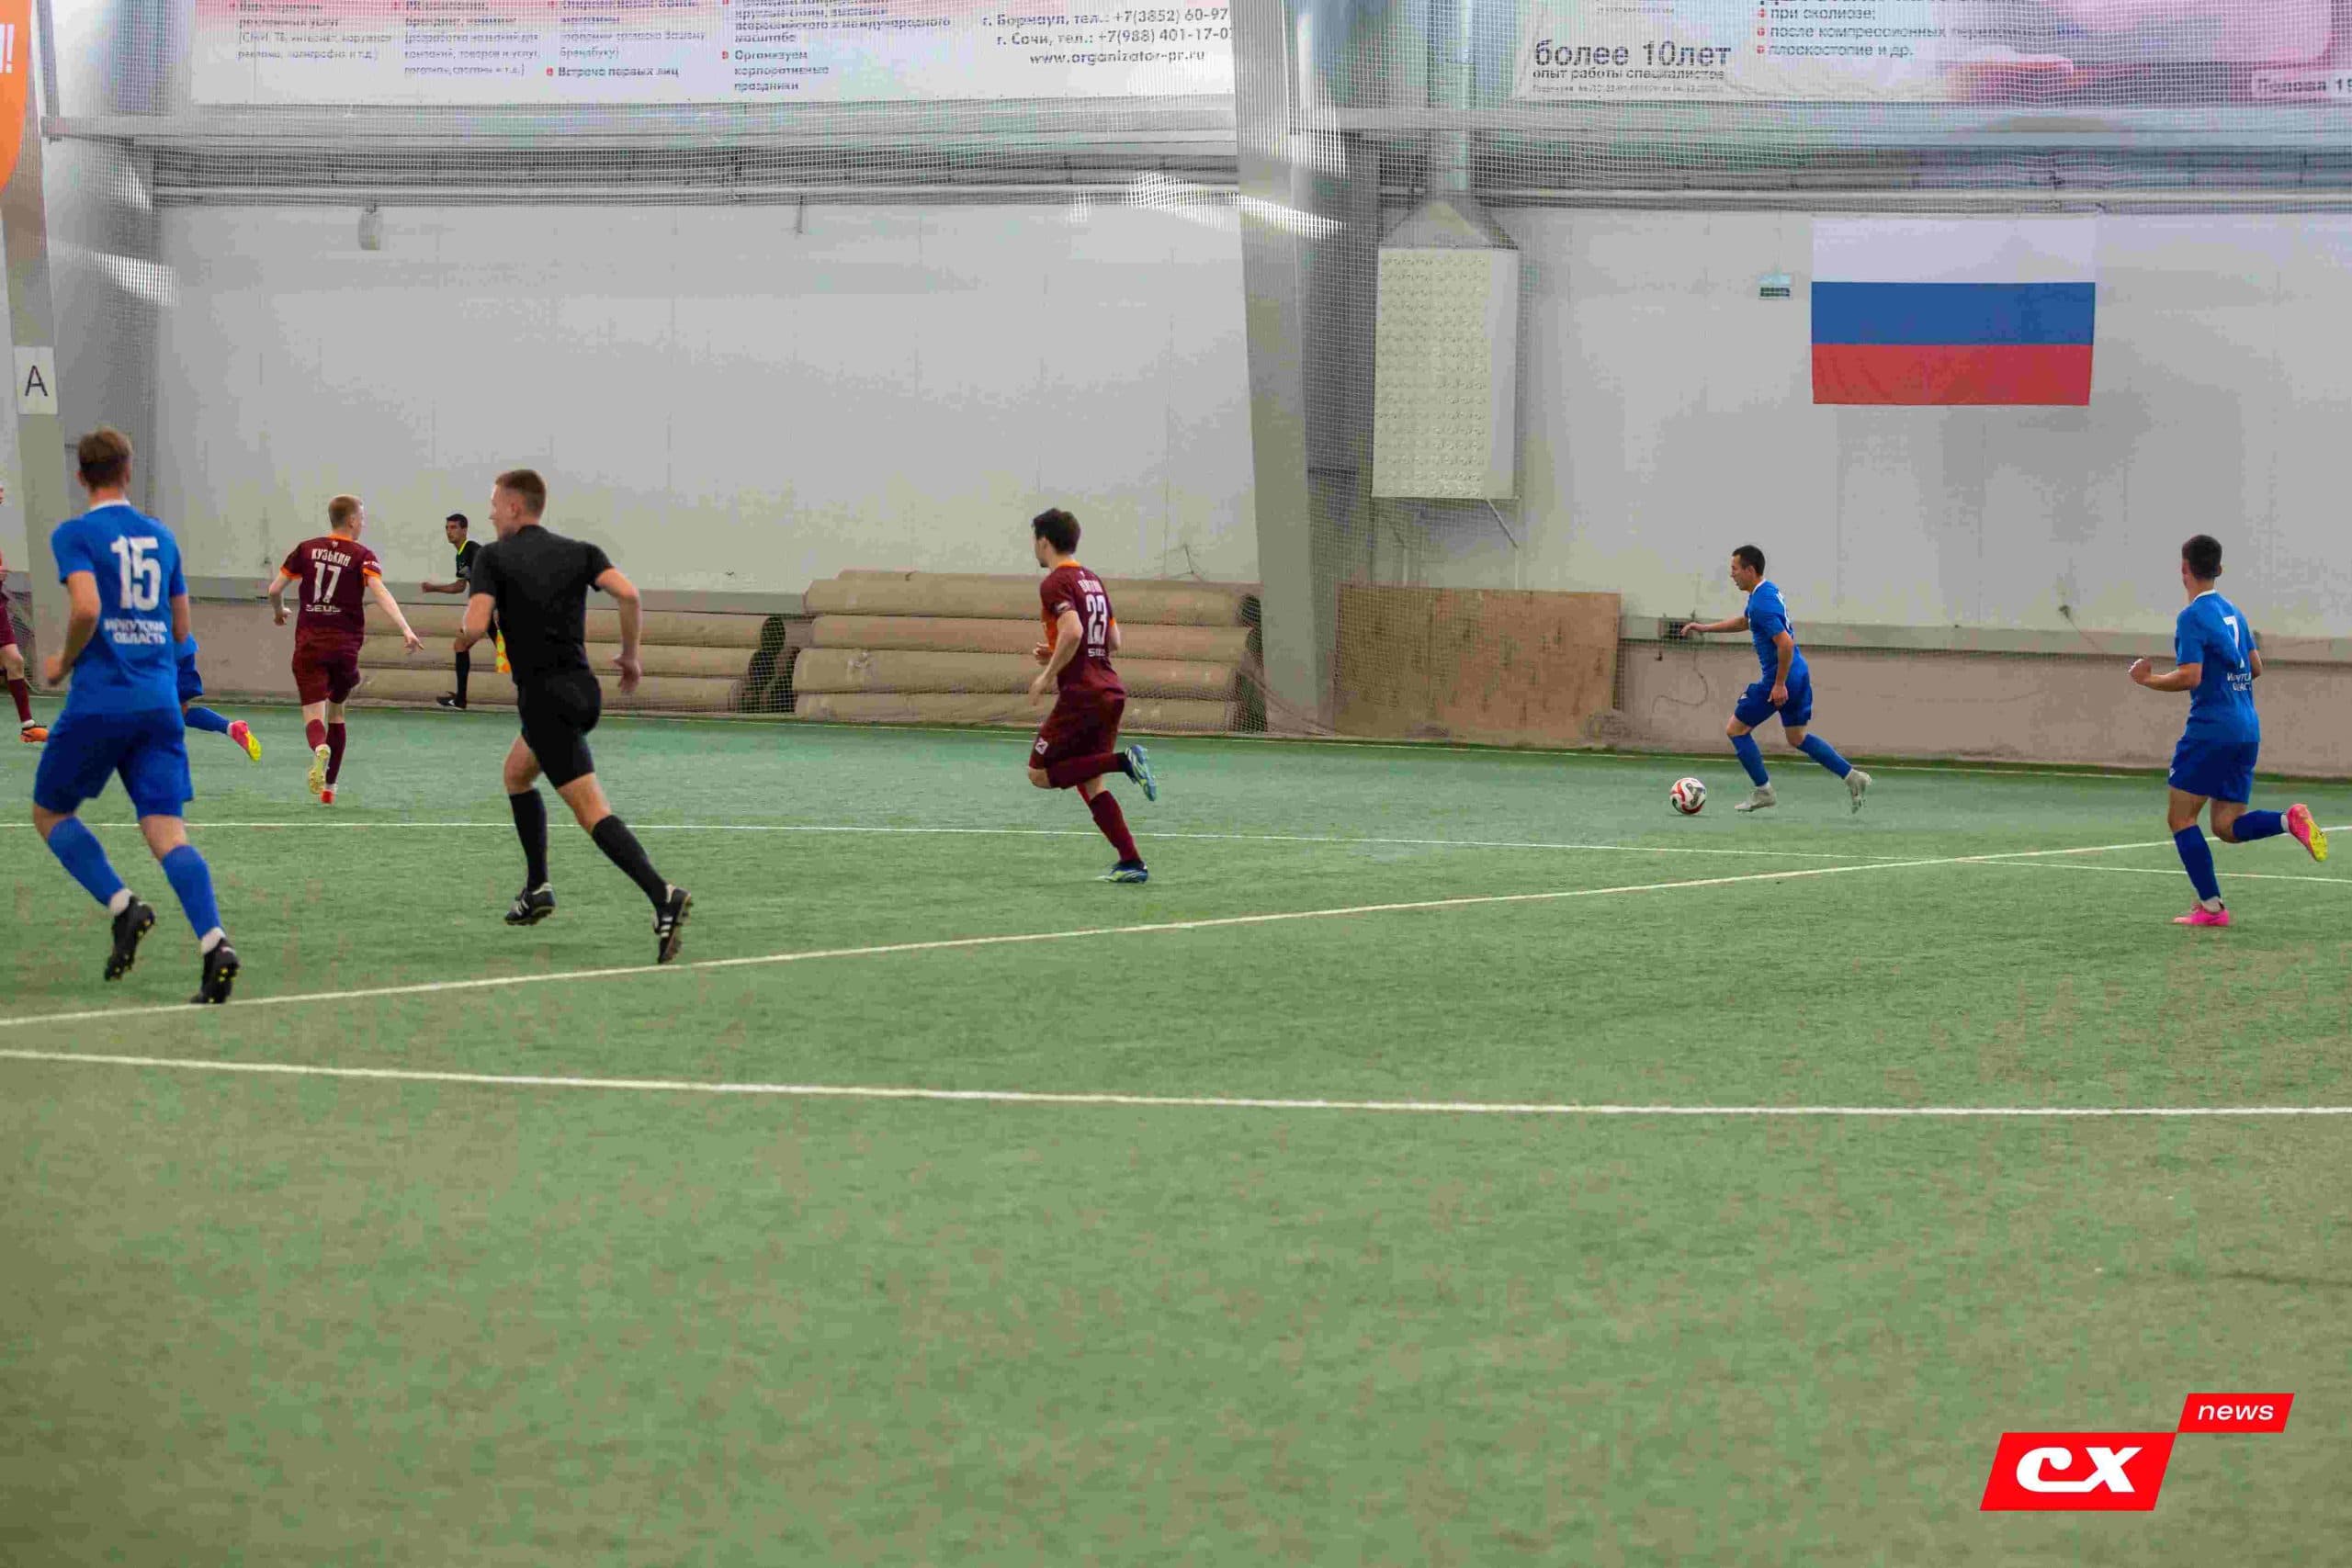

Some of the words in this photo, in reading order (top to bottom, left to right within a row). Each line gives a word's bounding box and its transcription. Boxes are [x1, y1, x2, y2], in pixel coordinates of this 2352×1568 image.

[997, 13, 1070, 28] Барнаул,
[1770, 9, 1799, 21] при
[1803, 8, 1876, 20] сколиозе;
[842, 17, 951, 31] международного
[1011, 33, 1053, 46] Сочи,
[1159, 27, 1235, 42] 401-17-0
[1770, 27, 1815, 38] после
[1029, 49, 1205, 66] www.organizator-pr.ru
[1535, 39, 1630, 67] более
[1890, 46, 1915, 59] др.
[558, 66, 605, 78] Встреча
[1532, 68, 1570, 81] опыт
[1571, 66, 1623, 81] работы
[734, 82, 799, 93] праздники
[311, 547, 353, 568] КУЗЬКИН
[110, 535, 162, 612] 15
[313, 561, 342, 604] 17
[2223, 615, 2245, 670] 7
